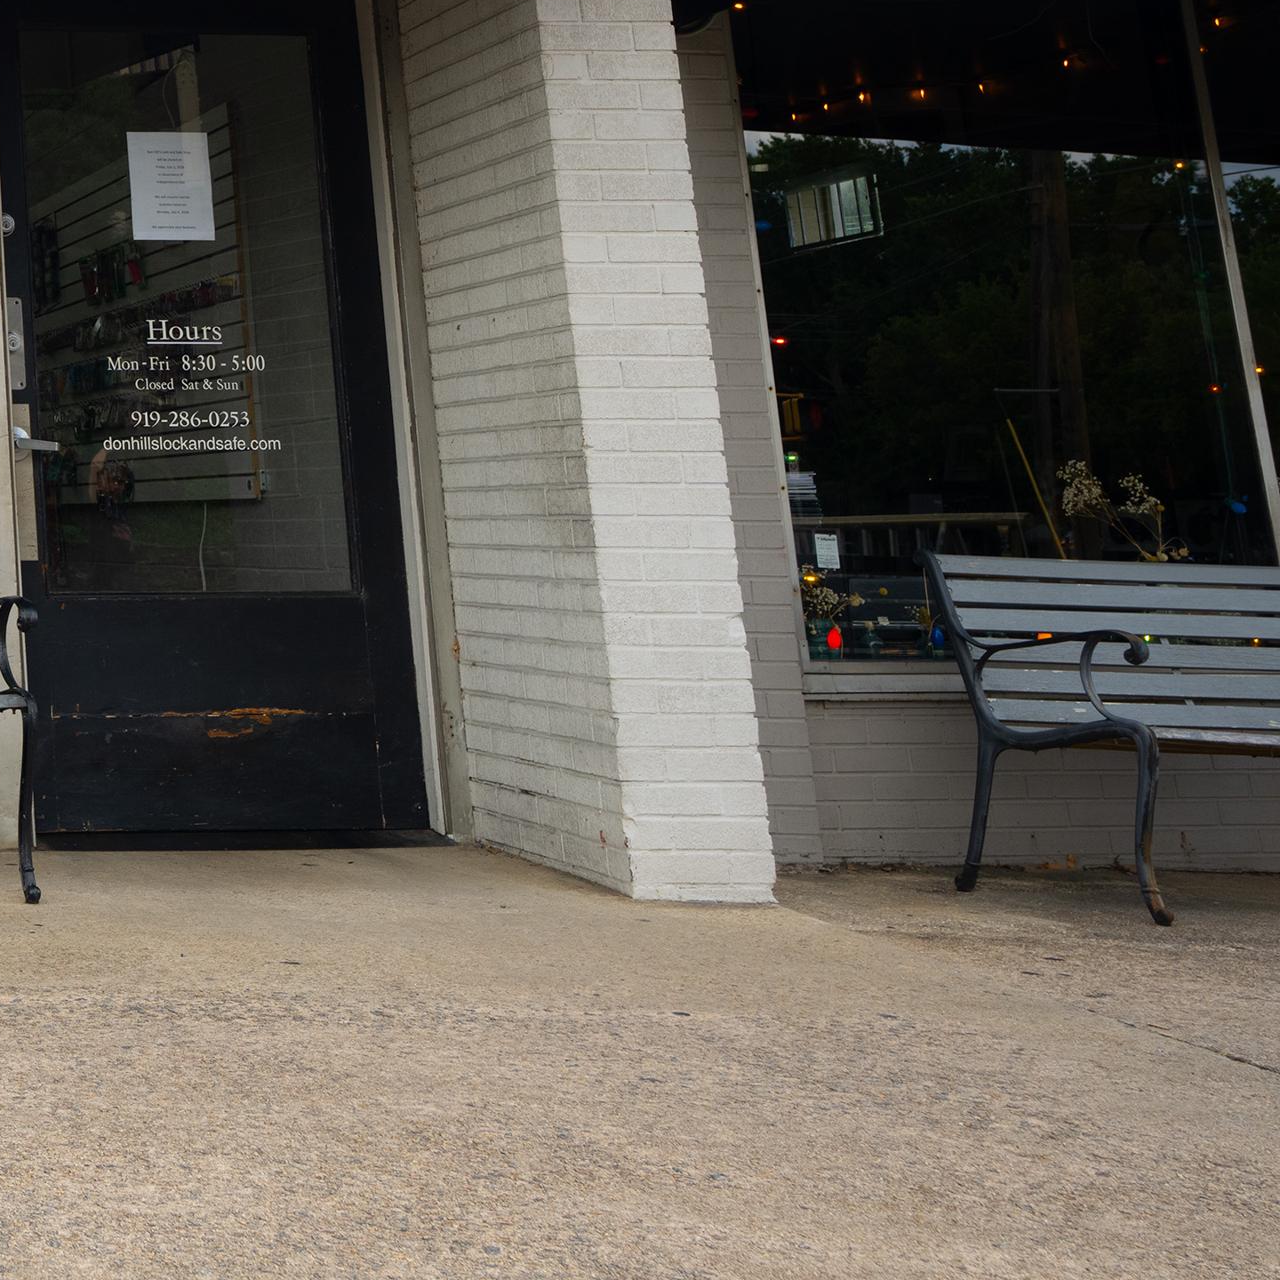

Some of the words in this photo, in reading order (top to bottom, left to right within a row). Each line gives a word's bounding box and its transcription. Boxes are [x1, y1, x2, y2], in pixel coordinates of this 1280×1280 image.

[145, 319, 223, 345] Hours
[181, 354, 216, 371] 8:30
[231, 354, 266, 372] 5:00
[134, 377, 175, 391] Closed
[181, 378, 200, 391] Sat
[202, 378, 214, 391] &
[216, 378, 239, 391] Sun
[130, 410, 250, 428] 919-286-0253
[103, 435, 282, 451] donhillslockandsafe.com
